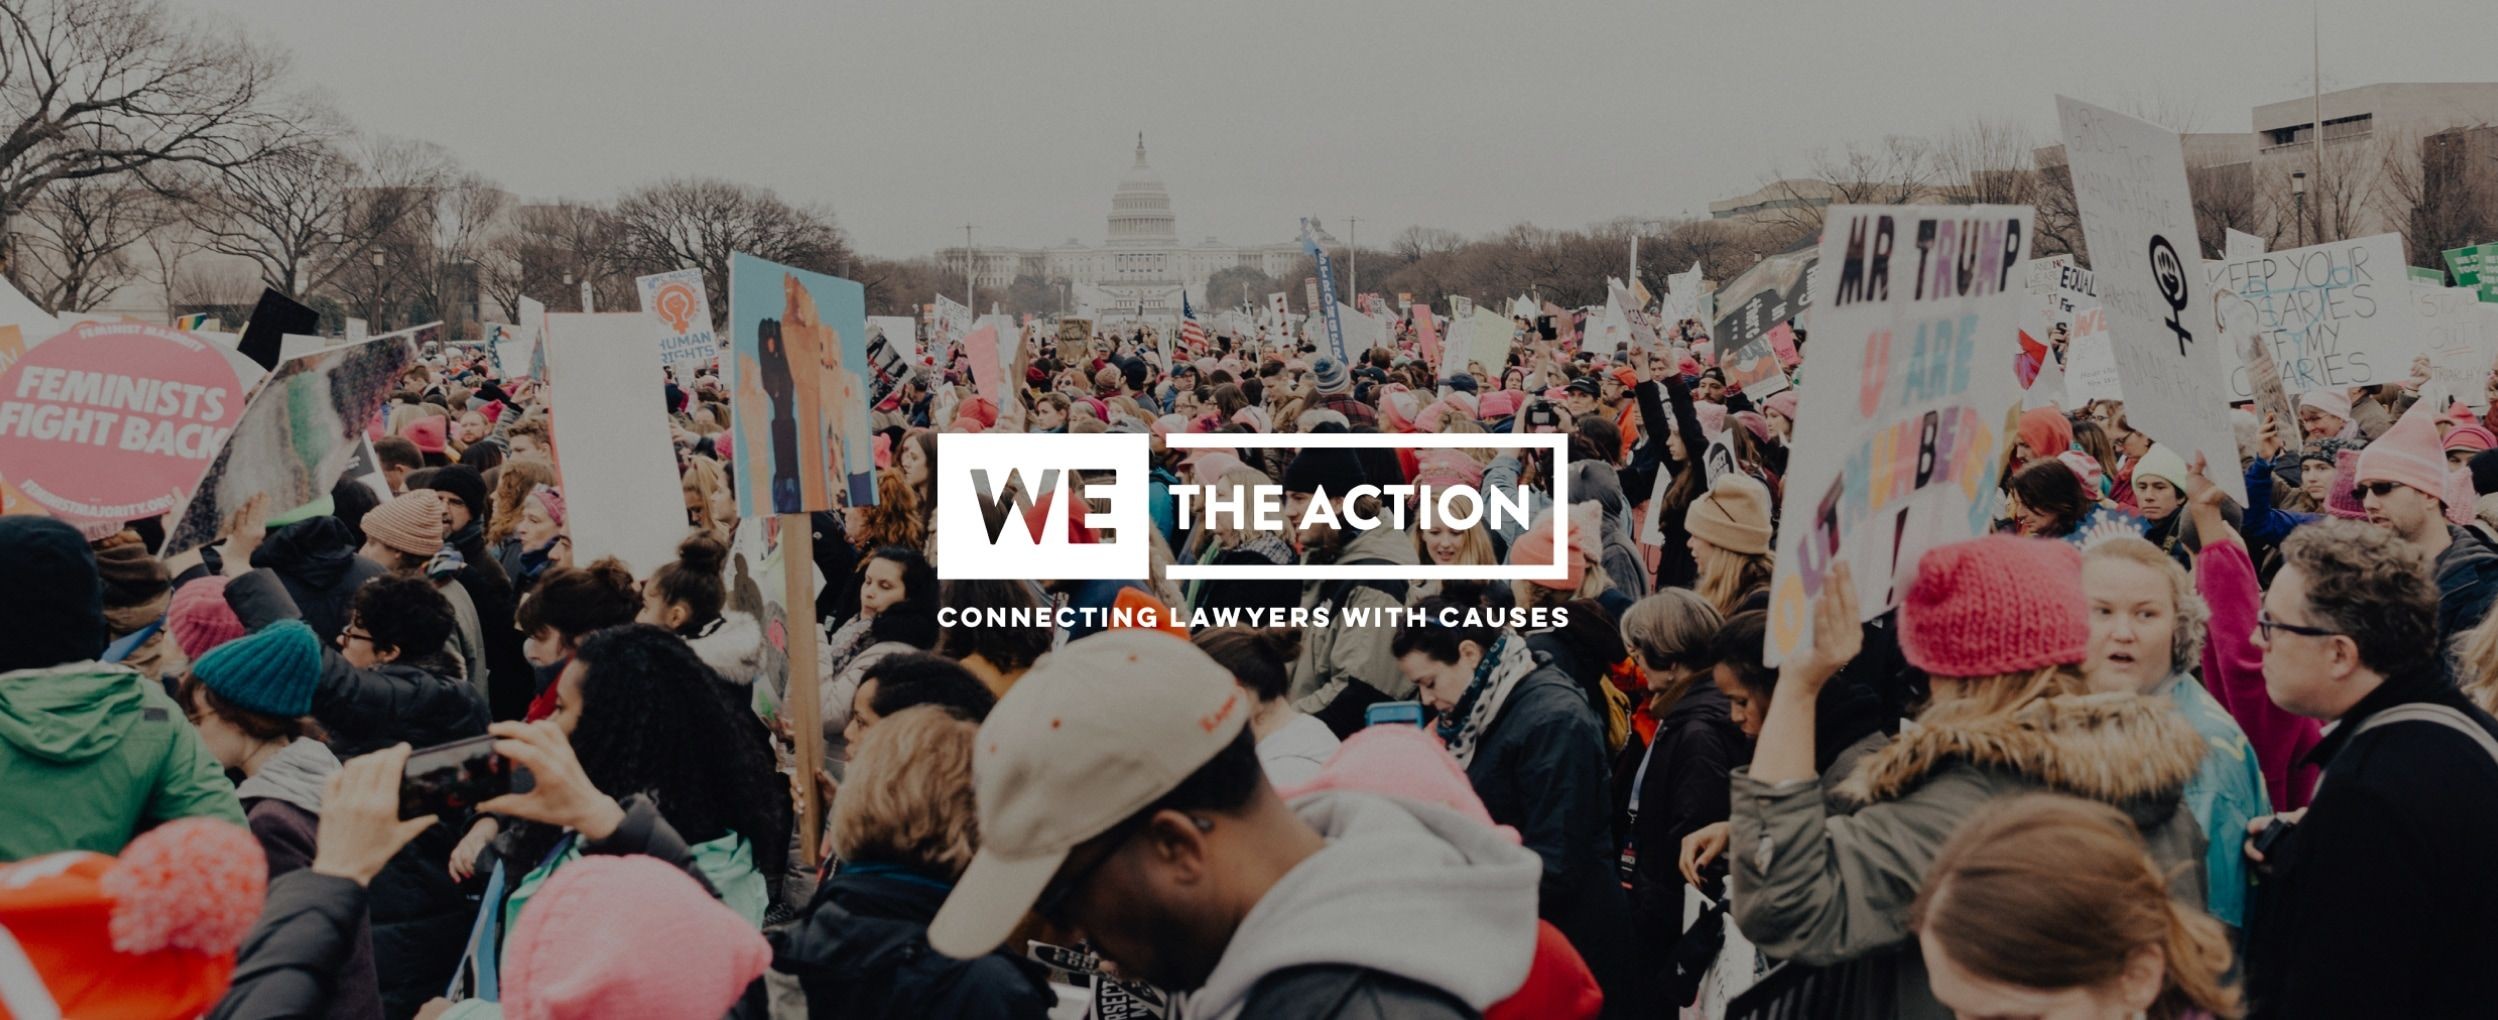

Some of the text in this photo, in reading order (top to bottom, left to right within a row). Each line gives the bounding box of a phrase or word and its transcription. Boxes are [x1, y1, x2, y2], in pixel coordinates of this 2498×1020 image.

[1834, 213, 2021, 307] MR TRUMP
[2059, 265, 2097, 298] EQUAL
[2206, 258, 2278, 294] KEEP
[2285, 245, 2375, 291] YOUR
[1318, 255, 1343, 359] STRONGER
[1744, 297, 1763, 340] there
[2305, 321, 2341, 356] MY
[1858, 313, 1979, 418] U ARE
[2231, 351, 2373, 397] OARIES
[15, 365, 227, 423] FEMINISTS
[0, 400, 233, 461] FIGHT BACK
